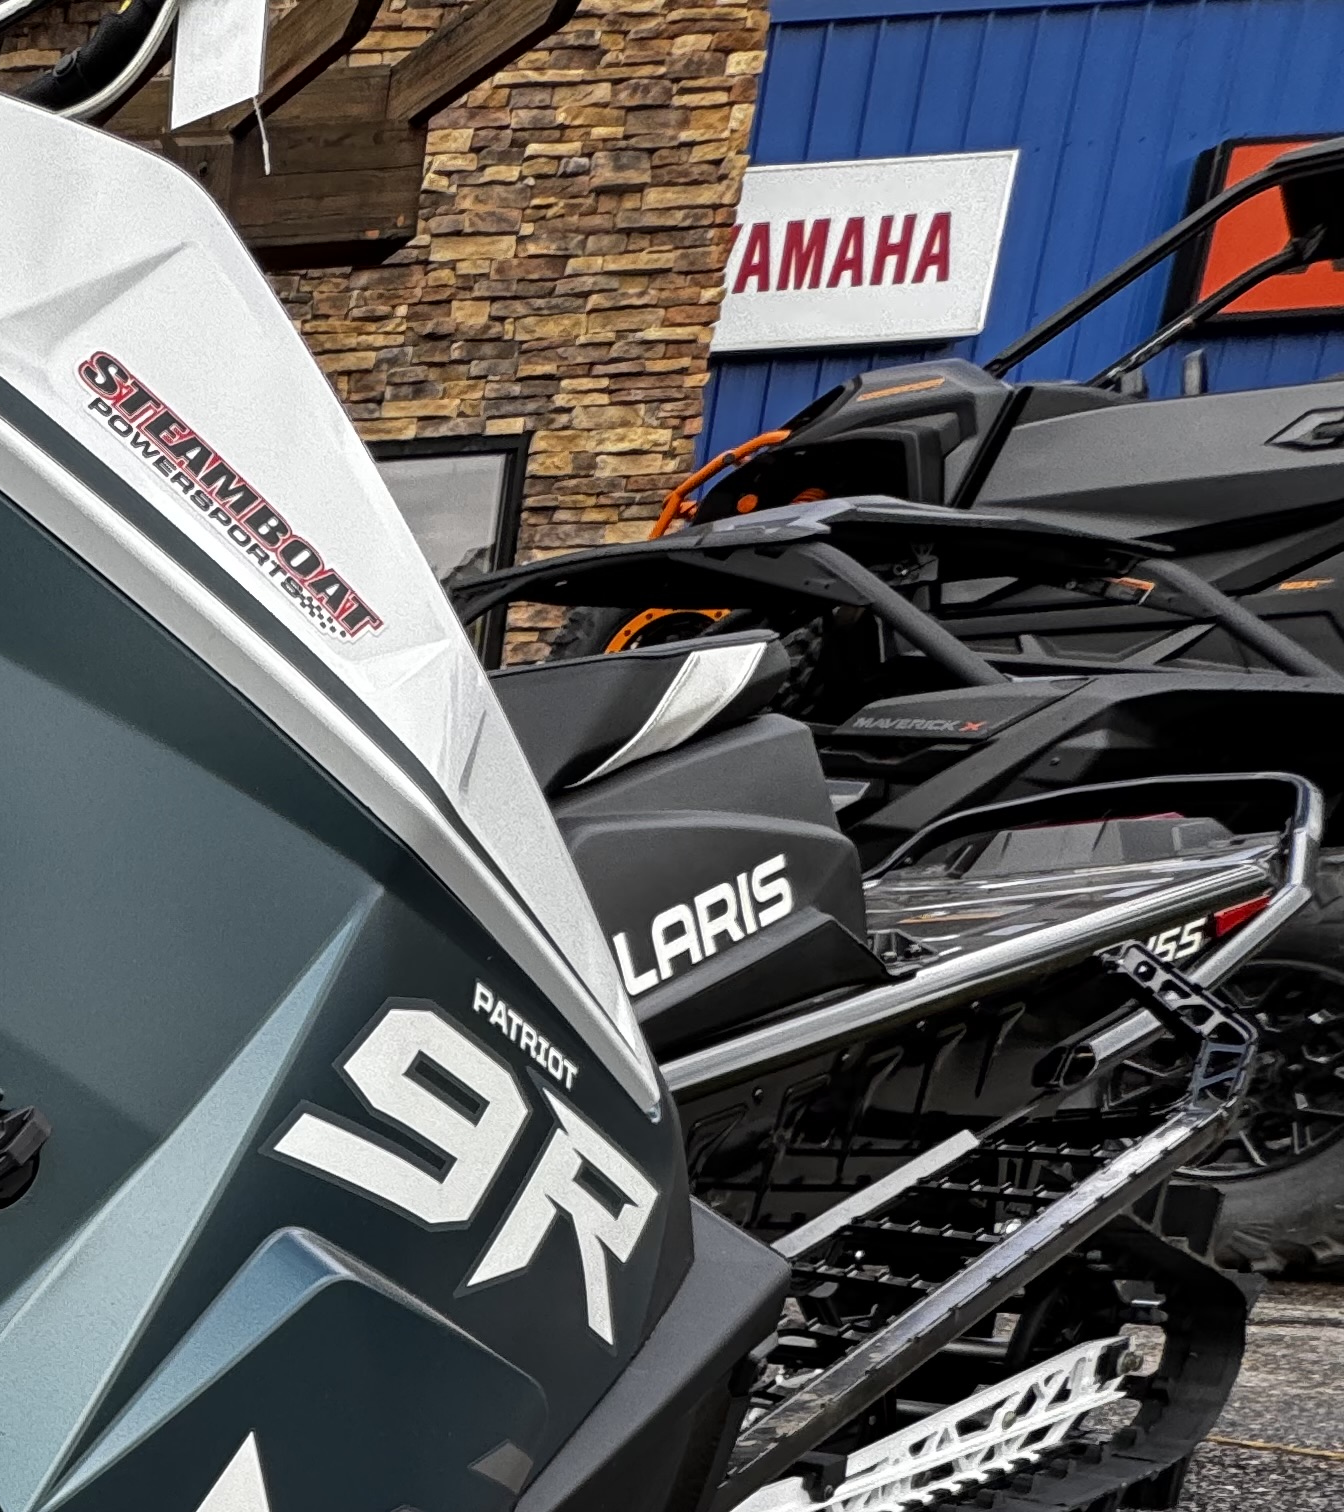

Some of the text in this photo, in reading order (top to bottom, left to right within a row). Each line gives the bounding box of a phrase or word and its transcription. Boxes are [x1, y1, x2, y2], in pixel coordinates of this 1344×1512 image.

[78, 351, 384, 638] STEAMBOAT
[88, 397, 305, 598] POWERSPORTS
[853, 717, 989, 732] MAVERICK X
[472, 979, 579, 1091] PATRIOT
[269, 1006, 660, 1346] 9R
